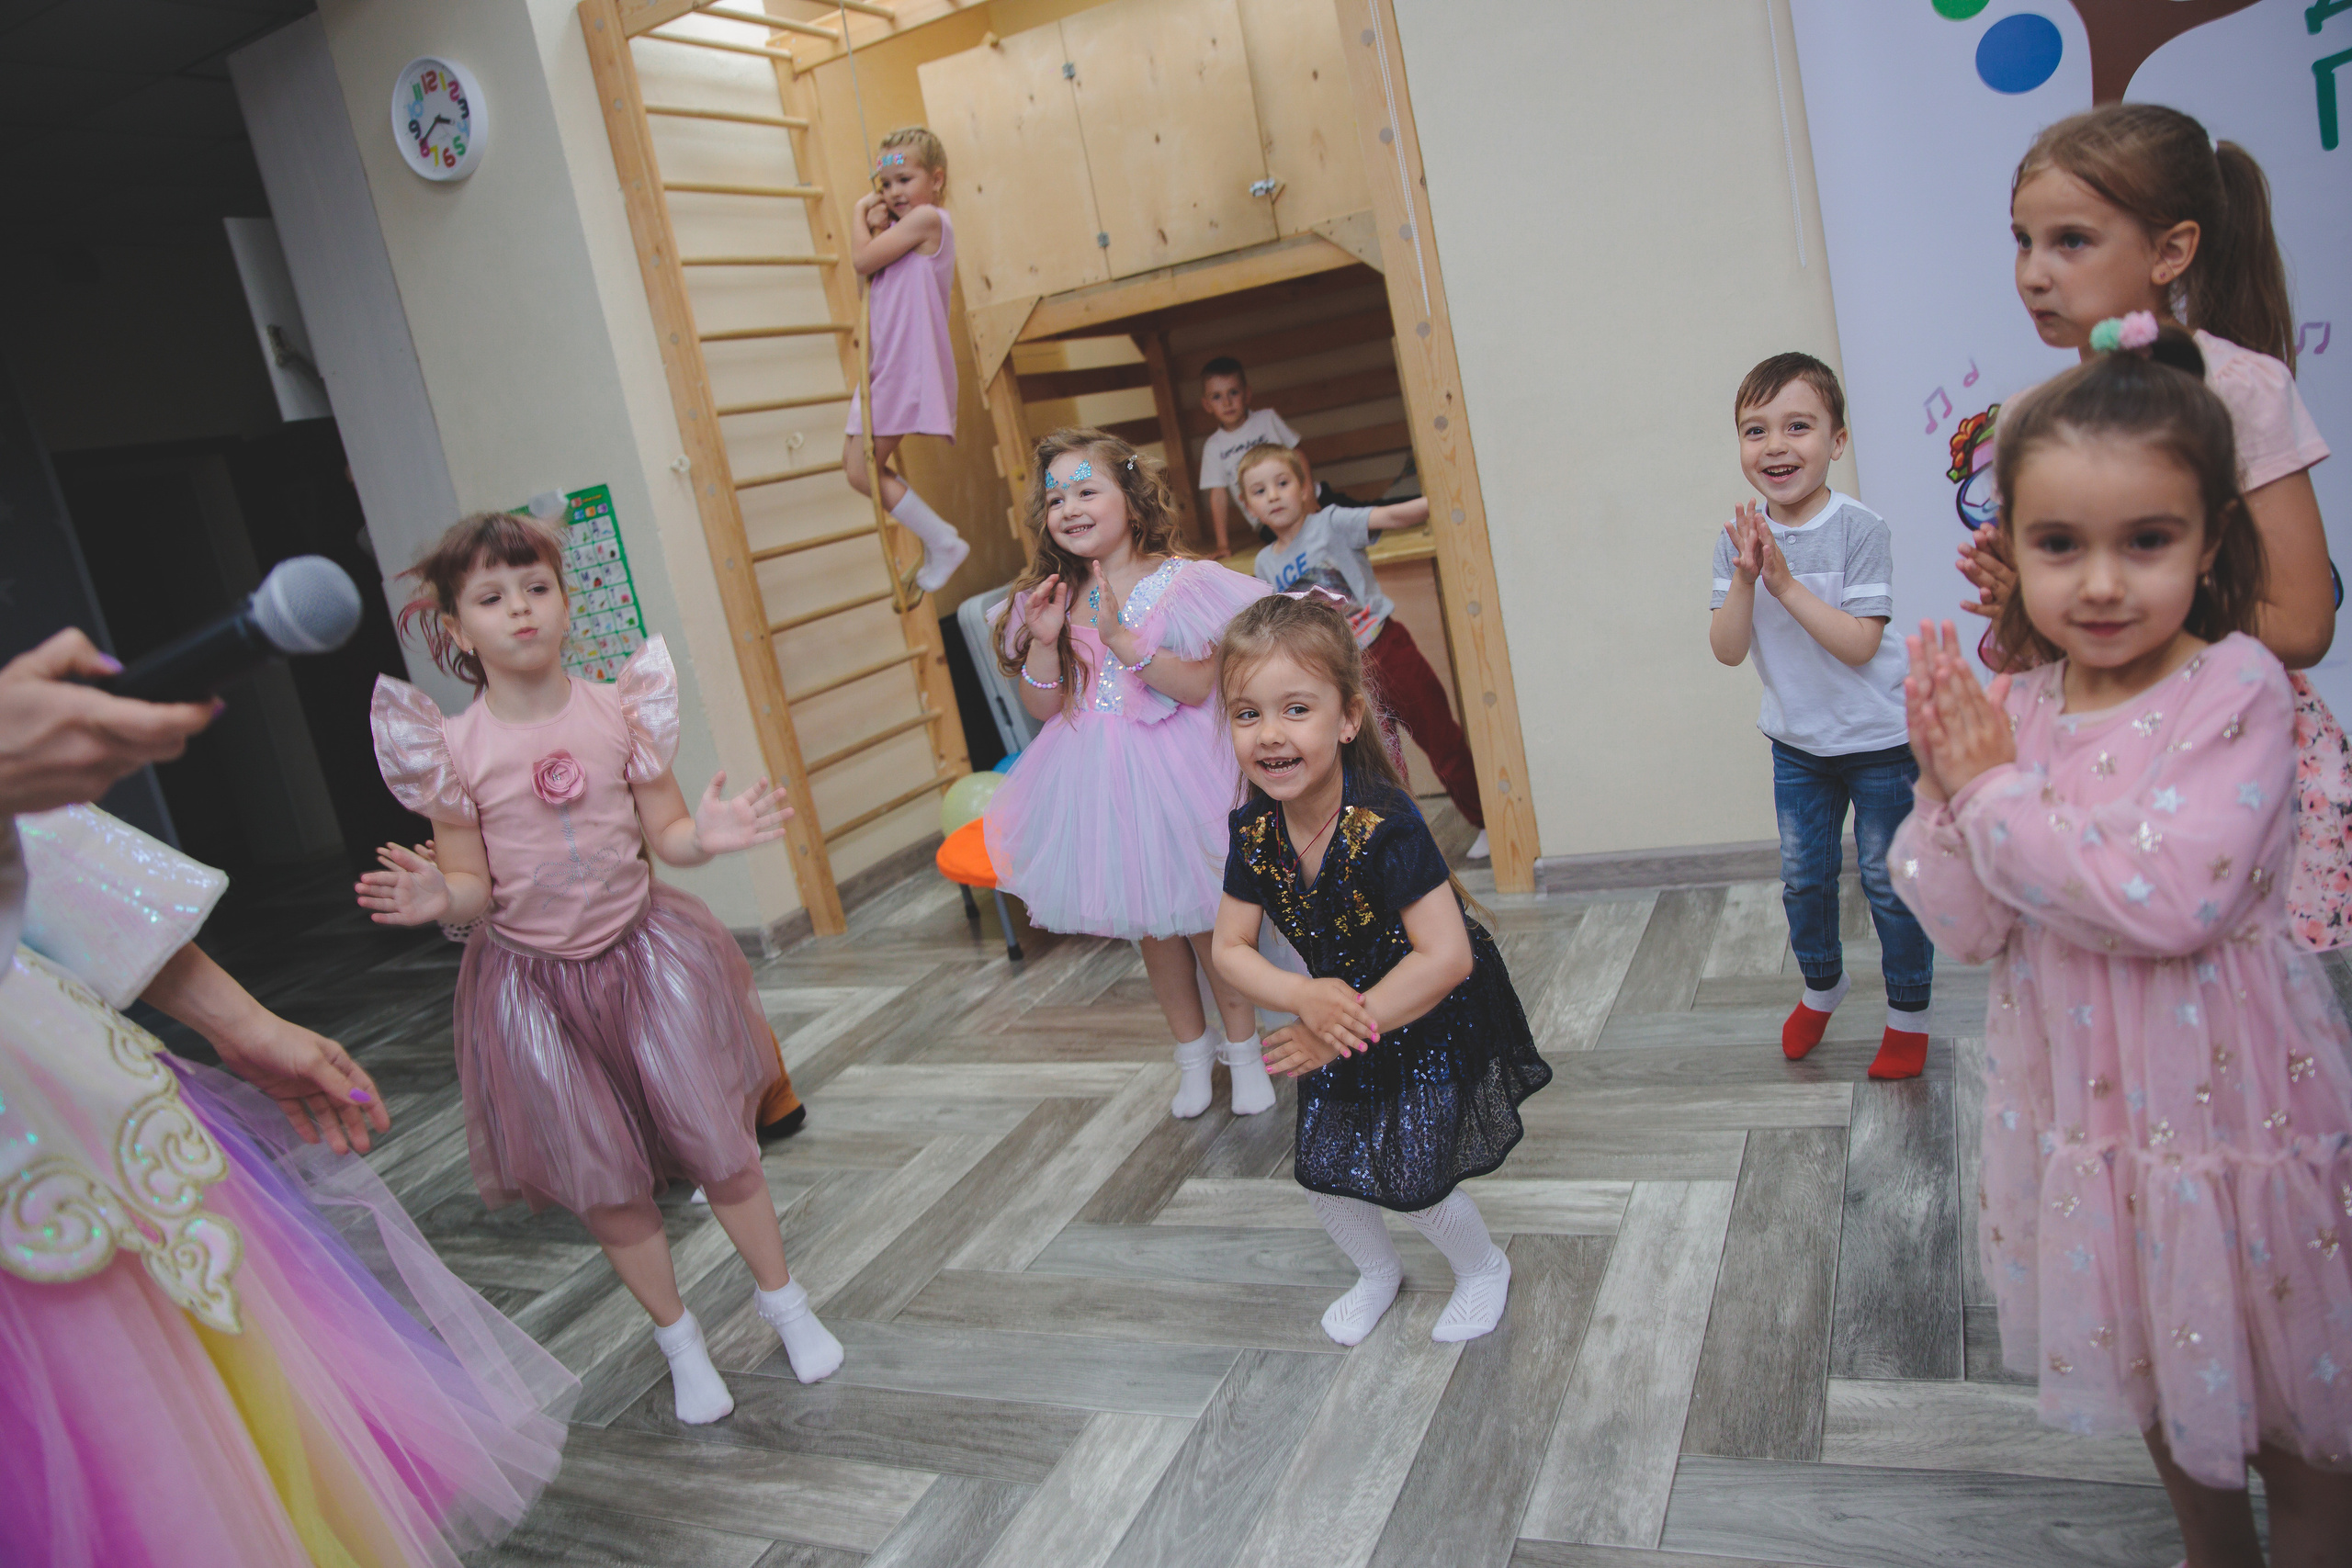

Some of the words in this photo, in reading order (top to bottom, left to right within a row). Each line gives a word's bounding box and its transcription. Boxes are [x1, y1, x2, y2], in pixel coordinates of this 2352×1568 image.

[421, 70, 438, 95] 12
[438, 71, 447, 91] 1
[447, 80, 459, 102] 2
[412, 82, 424, 102] 11
[407, 99, 424, 120] 10
[458, 98, 469, 119] 3
[408, 119, 422, 141] 9
[419, 138, 430, 158] 8
[429, 144, 439, 167] 7
[452, 135, 466, 156] 5
[442, 147, 456, 168] 6
[1274, 551, 1310, 592] ACE
